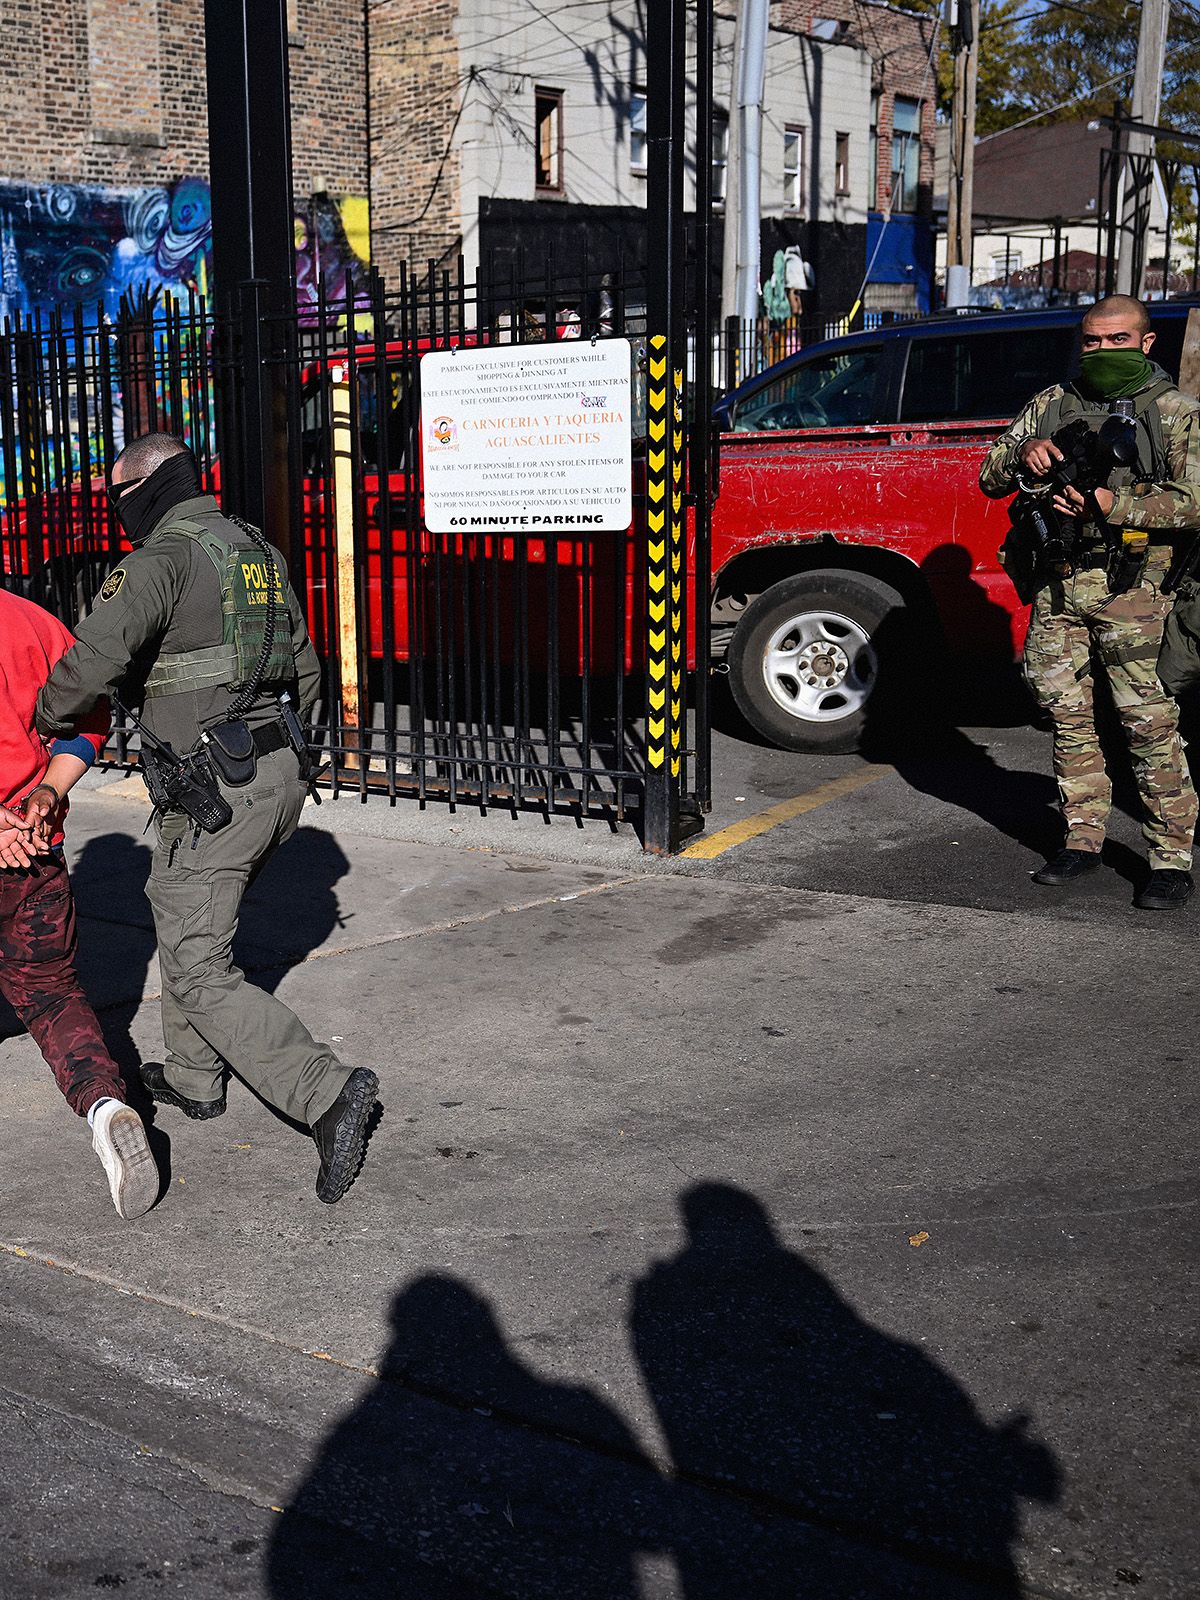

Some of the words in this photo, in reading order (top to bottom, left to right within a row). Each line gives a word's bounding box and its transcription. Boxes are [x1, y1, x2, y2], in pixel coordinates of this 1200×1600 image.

[441, 365, 474, 373] PARKING
[476, 361, 515, 370] EXCLUSIVE
[534, 356, 580, 366] CUSTOMERS
[581, 354, 607, 362] WHILE
[477, 372, 514, 381] SHOPPING
[522, 369, 556, 378] DINNING
[441, 386, 508, 396] ESTACIONAMIENTO
[520, 381, 586, 391] EXCLUSIVAMENTE
[588, 378, 629, 386] MIENTRAS
[479, 396, 518, 404] COMIENDO
[526, 392, 574, 401] COMPRANDO
[543, 415, 551, 426] Y
[485, 432, 600, 448] AGUASCALIENTES
[474, 462, 521, 470] RESPONSIBLE
[557, 459, 586, 467] STOLEN
[482, 472, 514, 480] DAMAGE
[465, 489, 519, 497] RESPONSABLES
[537, 488, 579, 496] ARTICULOS
[489, 499, 511, 507] DAÑO
[450, 517, 467, 525] 60
[470, 516, 529, 525] MINUTE
[532, 515, 603, 524] PARKING
